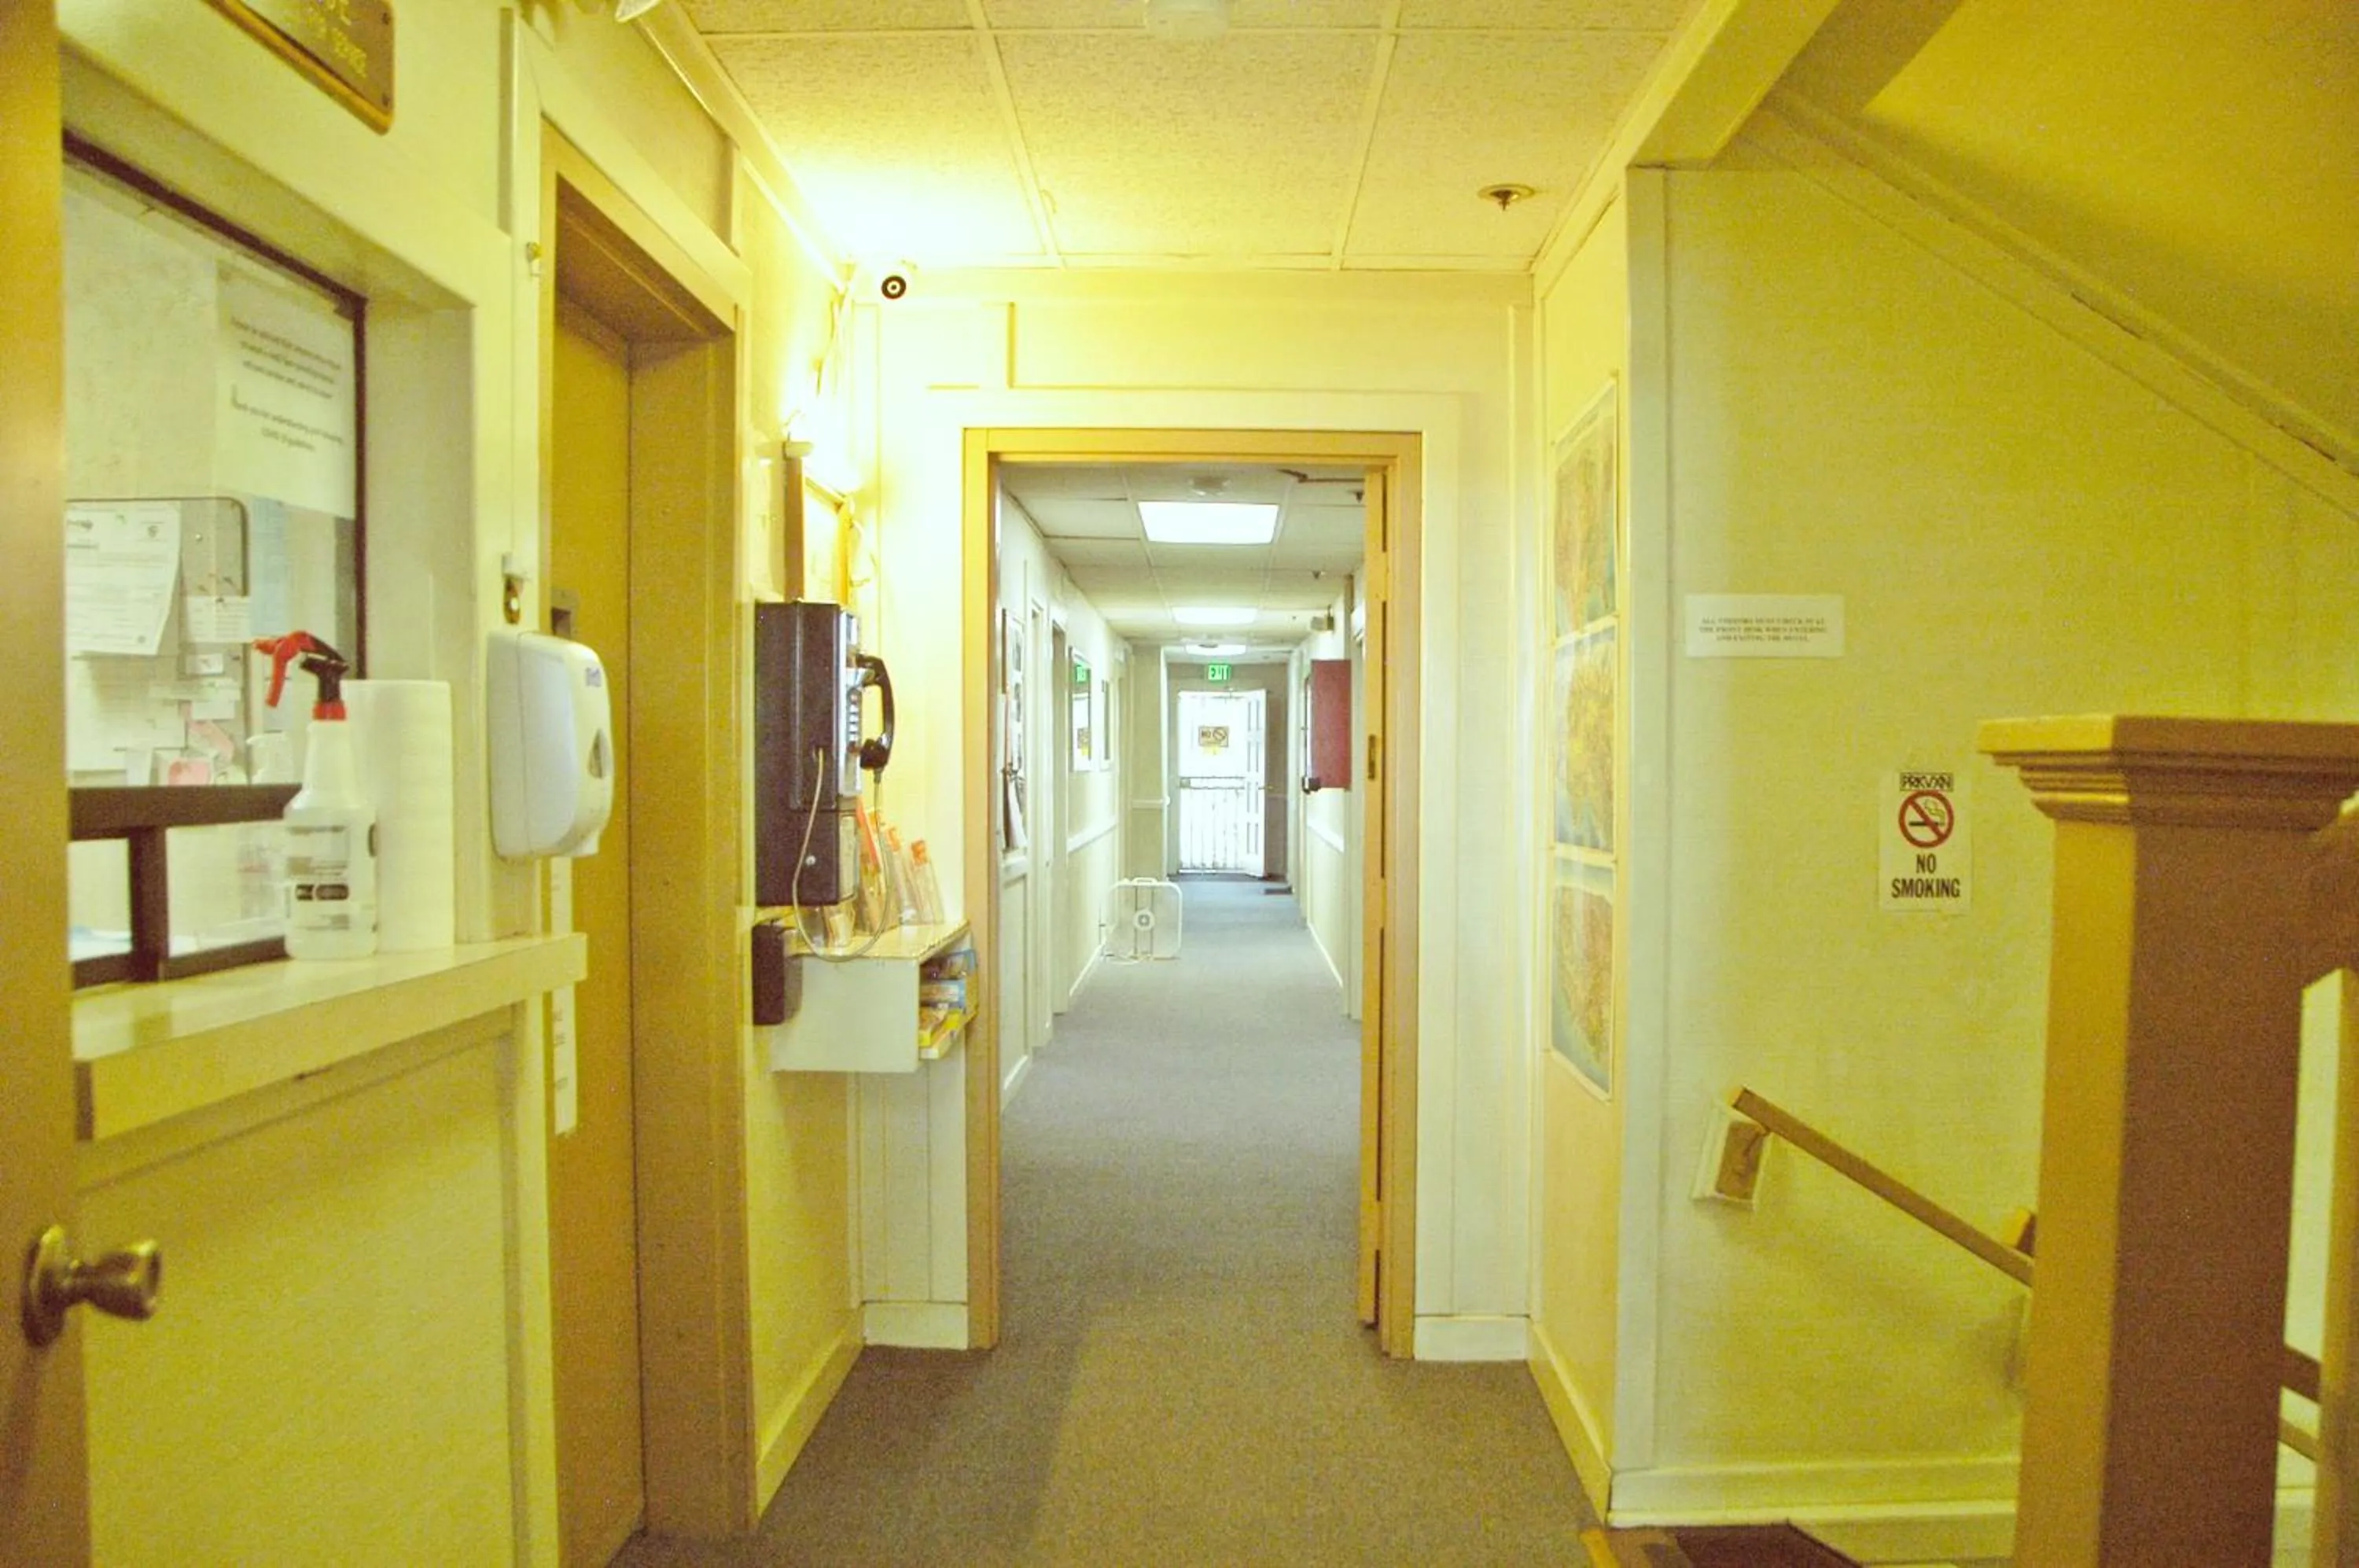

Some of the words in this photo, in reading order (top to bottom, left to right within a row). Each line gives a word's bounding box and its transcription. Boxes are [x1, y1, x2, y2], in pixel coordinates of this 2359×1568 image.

[1208, 664, 1228, 680] EXIT
[1916, 853, 1937, 874] NO
[1890, 877, 1961, 899] SMOKING
